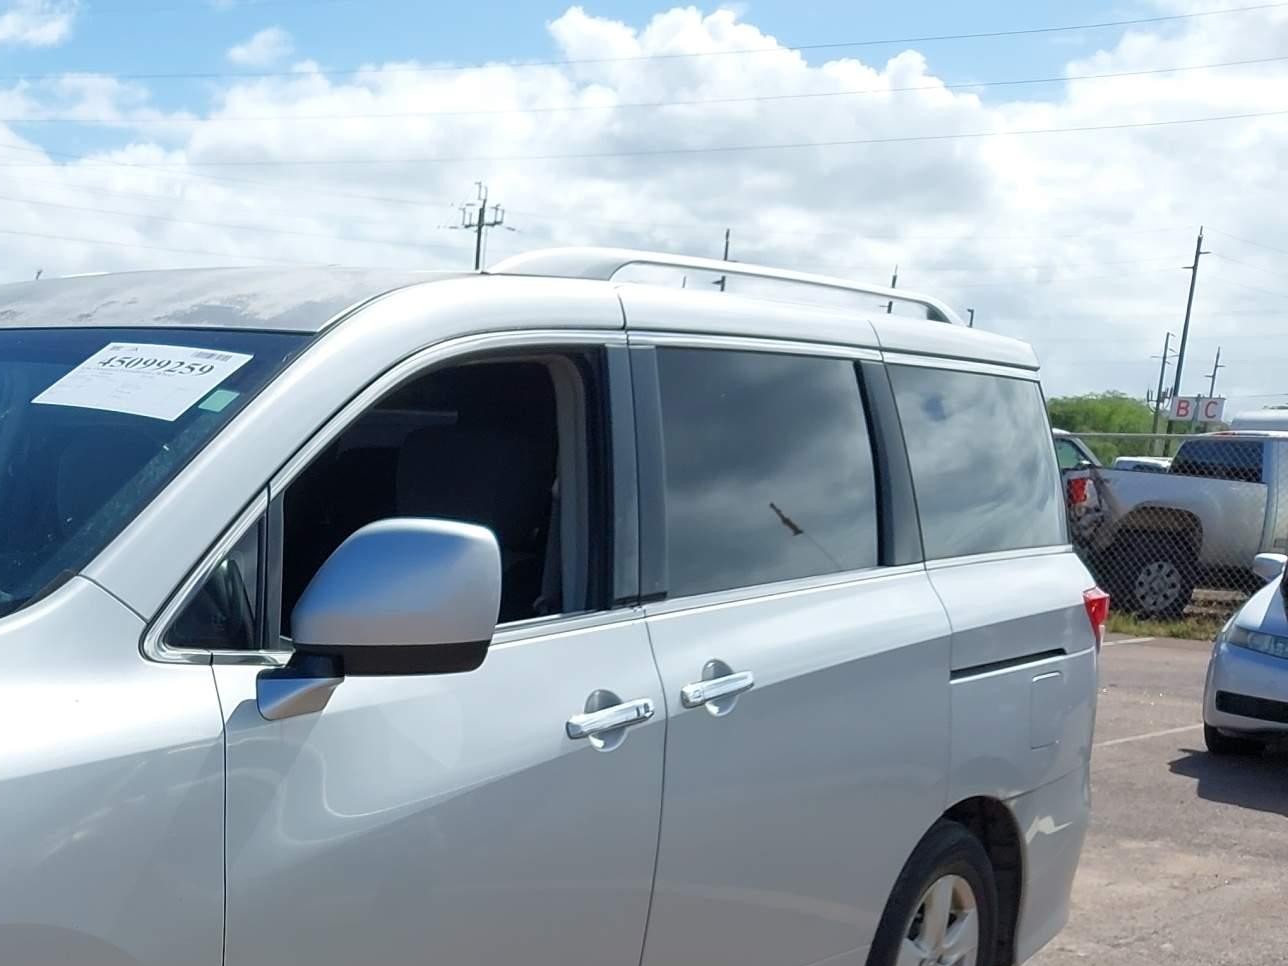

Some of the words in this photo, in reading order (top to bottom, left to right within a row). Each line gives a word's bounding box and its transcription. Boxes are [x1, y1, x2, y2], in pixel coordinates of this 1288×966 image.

[98, 355, 215, 377] 45099259
[1176, 400, 1190, 418] B
[1204, 401, 1218, 419] C
